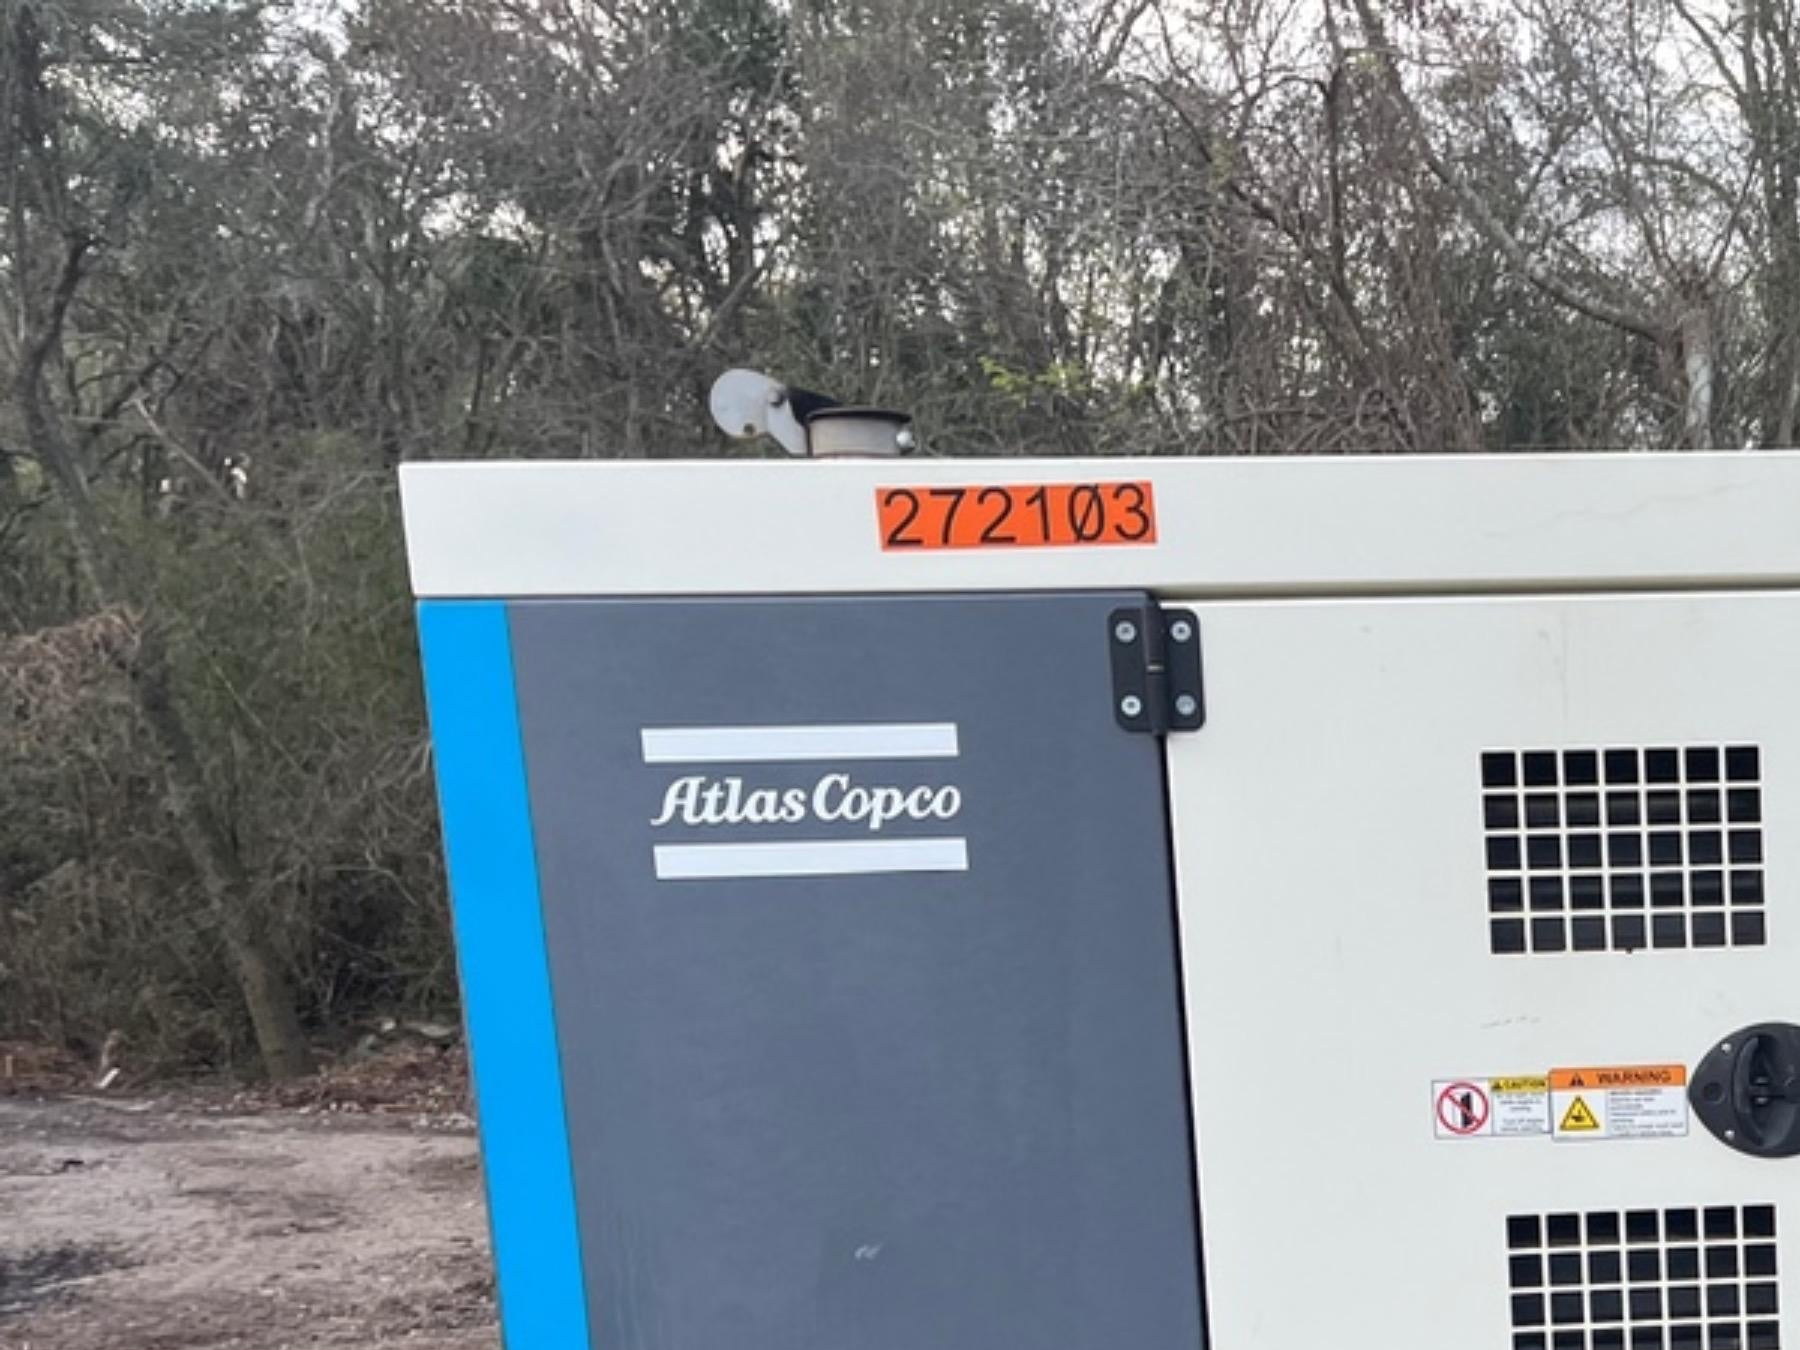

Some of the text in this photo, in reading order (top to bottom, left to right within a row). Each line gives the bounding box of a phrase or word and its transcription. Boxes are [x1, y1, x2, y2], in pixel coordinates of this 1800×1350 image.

[883, 482, 1151, 547] 272103
[650, 773, 961, 829] Atlas Copco
[1596, 1070, 1672, 1085] WARNING
